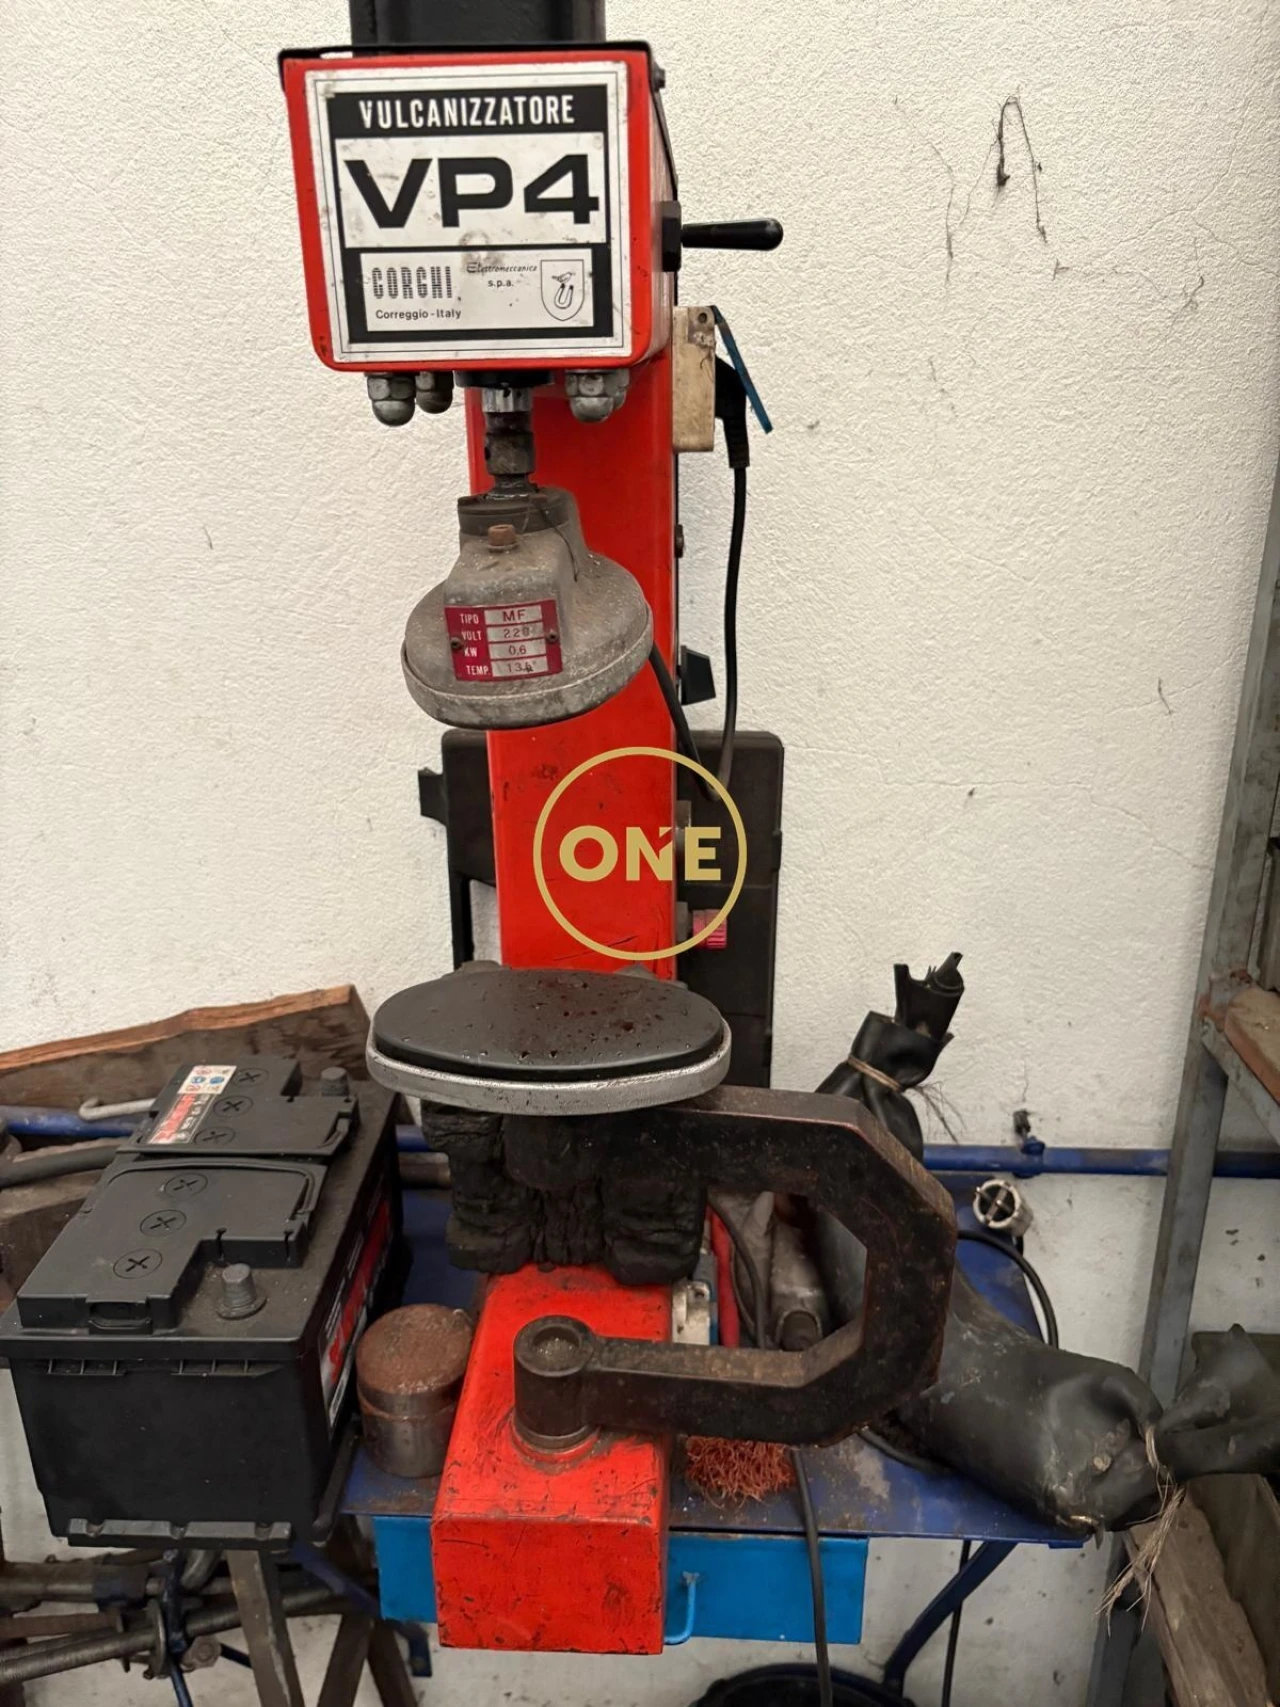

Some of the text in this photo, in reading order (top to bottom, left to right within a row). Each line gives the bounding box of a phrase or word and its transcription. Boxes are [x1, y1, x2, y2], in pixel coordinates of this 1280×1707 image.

[359, 95, 575, 129] VULCANIZZATORE
[344, 153, 600, 229] VP4
[372, 265, 453, 299] CORGHI
[487, 278, 514, 288] s.p.a.
[460, 608, 526, 624] TIPO MF
[461, 630, 482, 641] VOLT
[464, 646, 478, 657] KW
